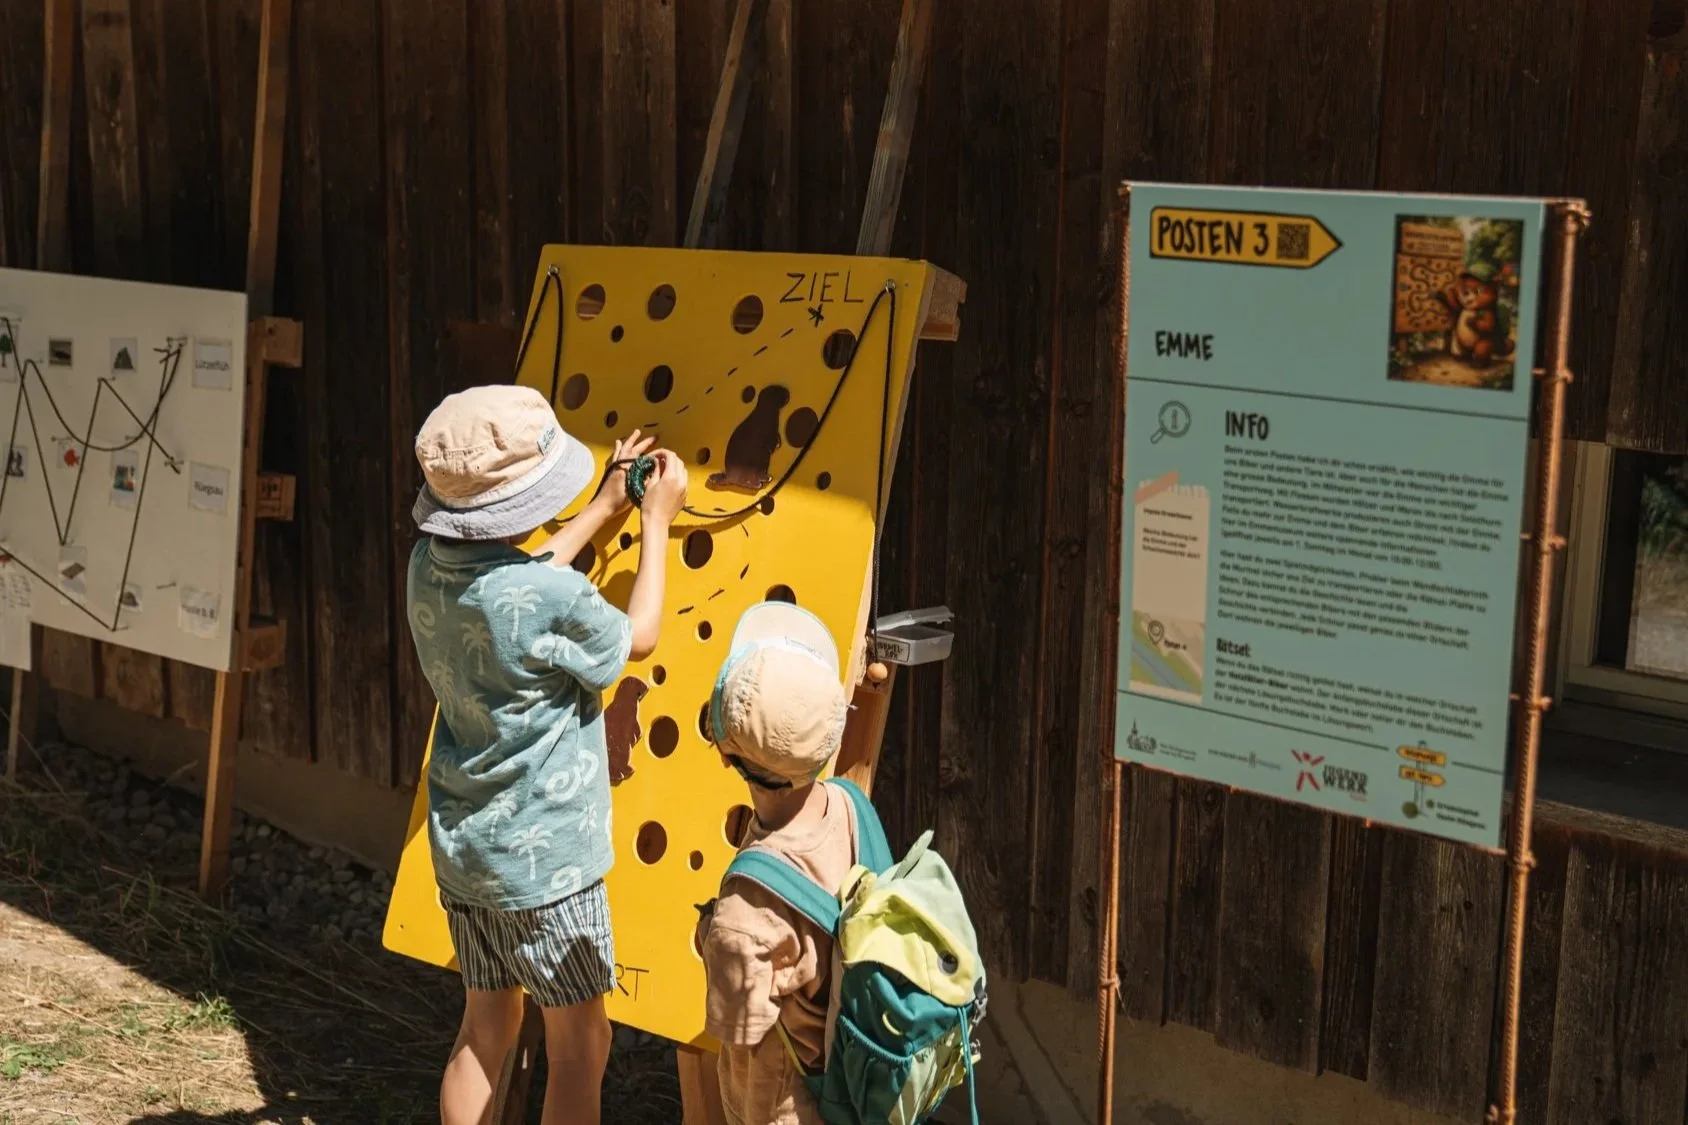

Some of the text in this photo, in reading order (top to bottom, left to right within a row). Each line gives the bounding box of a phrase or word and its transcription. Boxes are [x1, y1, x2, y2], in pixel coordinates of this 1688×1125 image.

[1158, 215, 1269, 257] POSTEN 3
[780, 269, 864, 303] ZIEL
[1155, 330, 1214, 361] EMME
[1225, 409, 1269, 441] INFO
[1322, 772, 1367, 794] WERK
[1323, 764, 1368, 783] JUGEND
